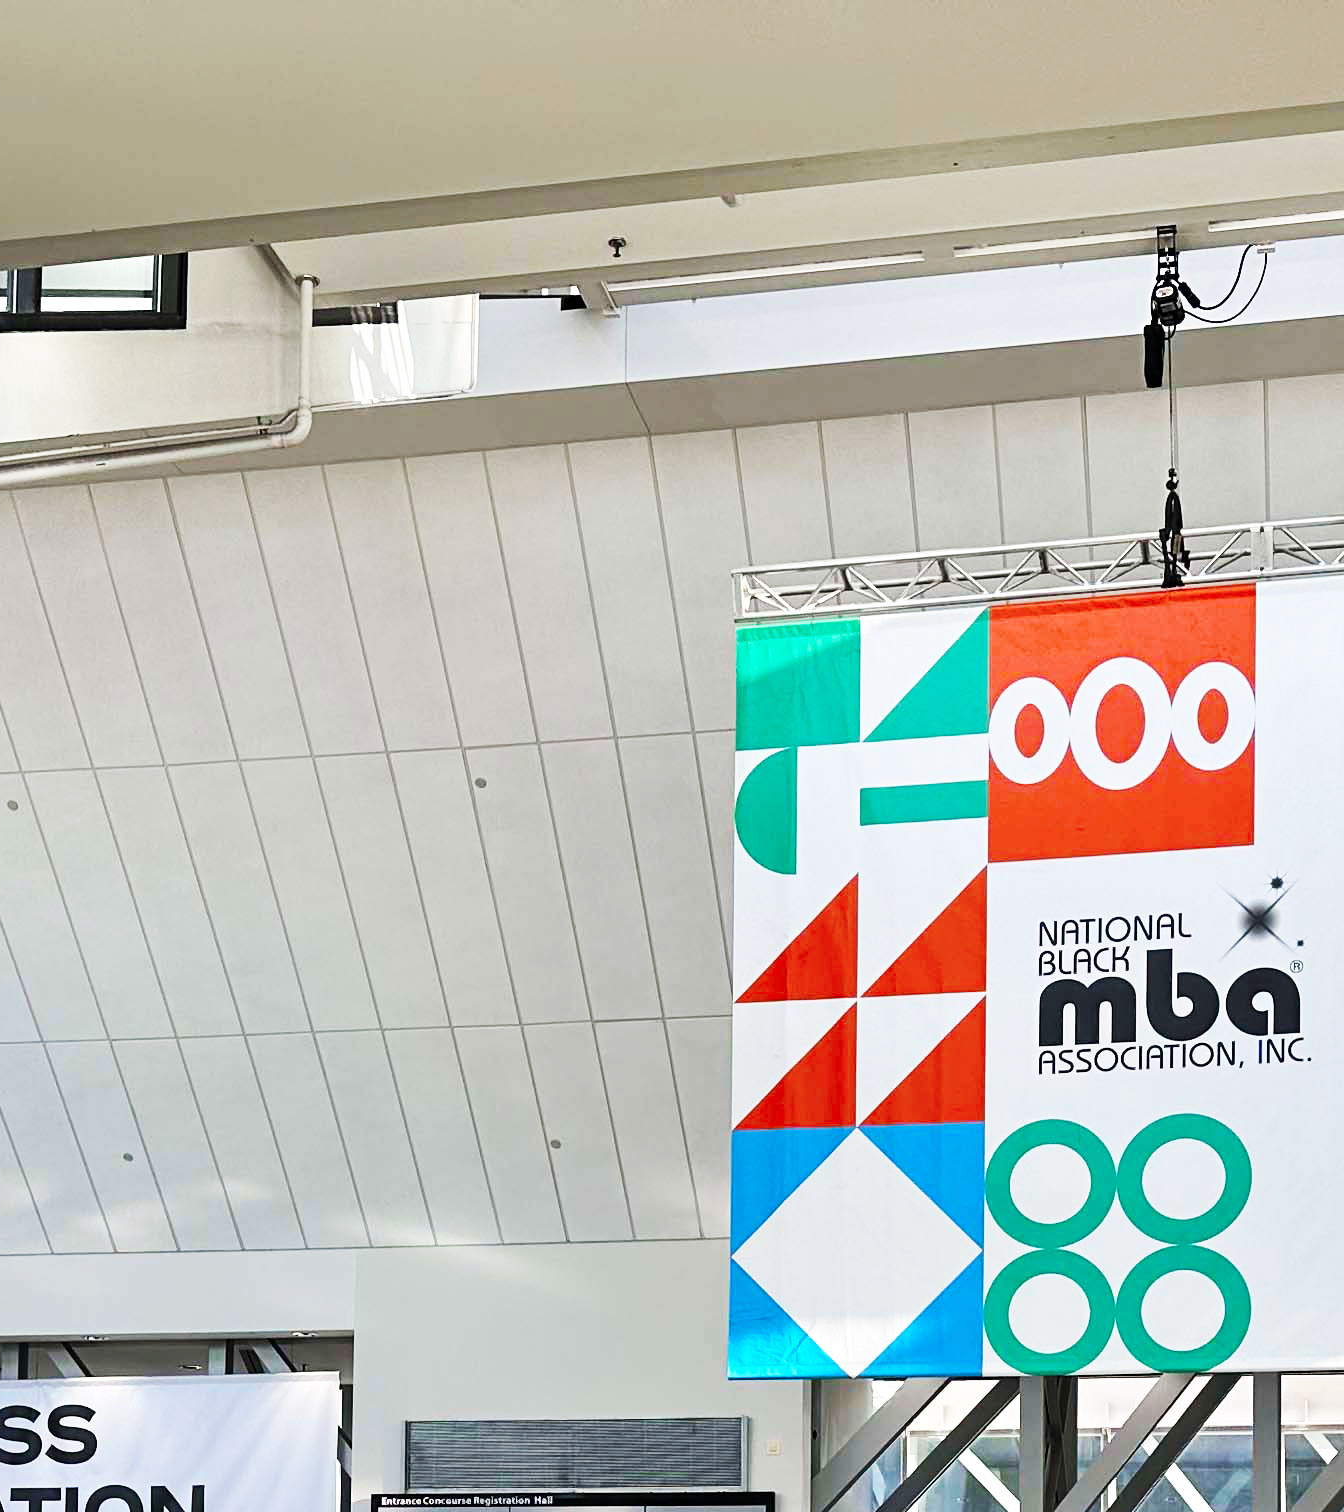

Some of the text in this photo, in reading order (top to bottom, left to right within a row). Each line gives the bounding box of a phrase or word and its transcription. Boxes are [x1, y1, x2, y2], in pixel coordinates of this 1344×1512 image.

[1039, 913, 1191, 946] NATIONAL
[1039, 946, 1130, 976] BLACK
[1039, 1037, 1312, 1075] ASSOCIATION, INC.
[381, 1495, 553, 1506] Entrance Concourse Registration Hall
